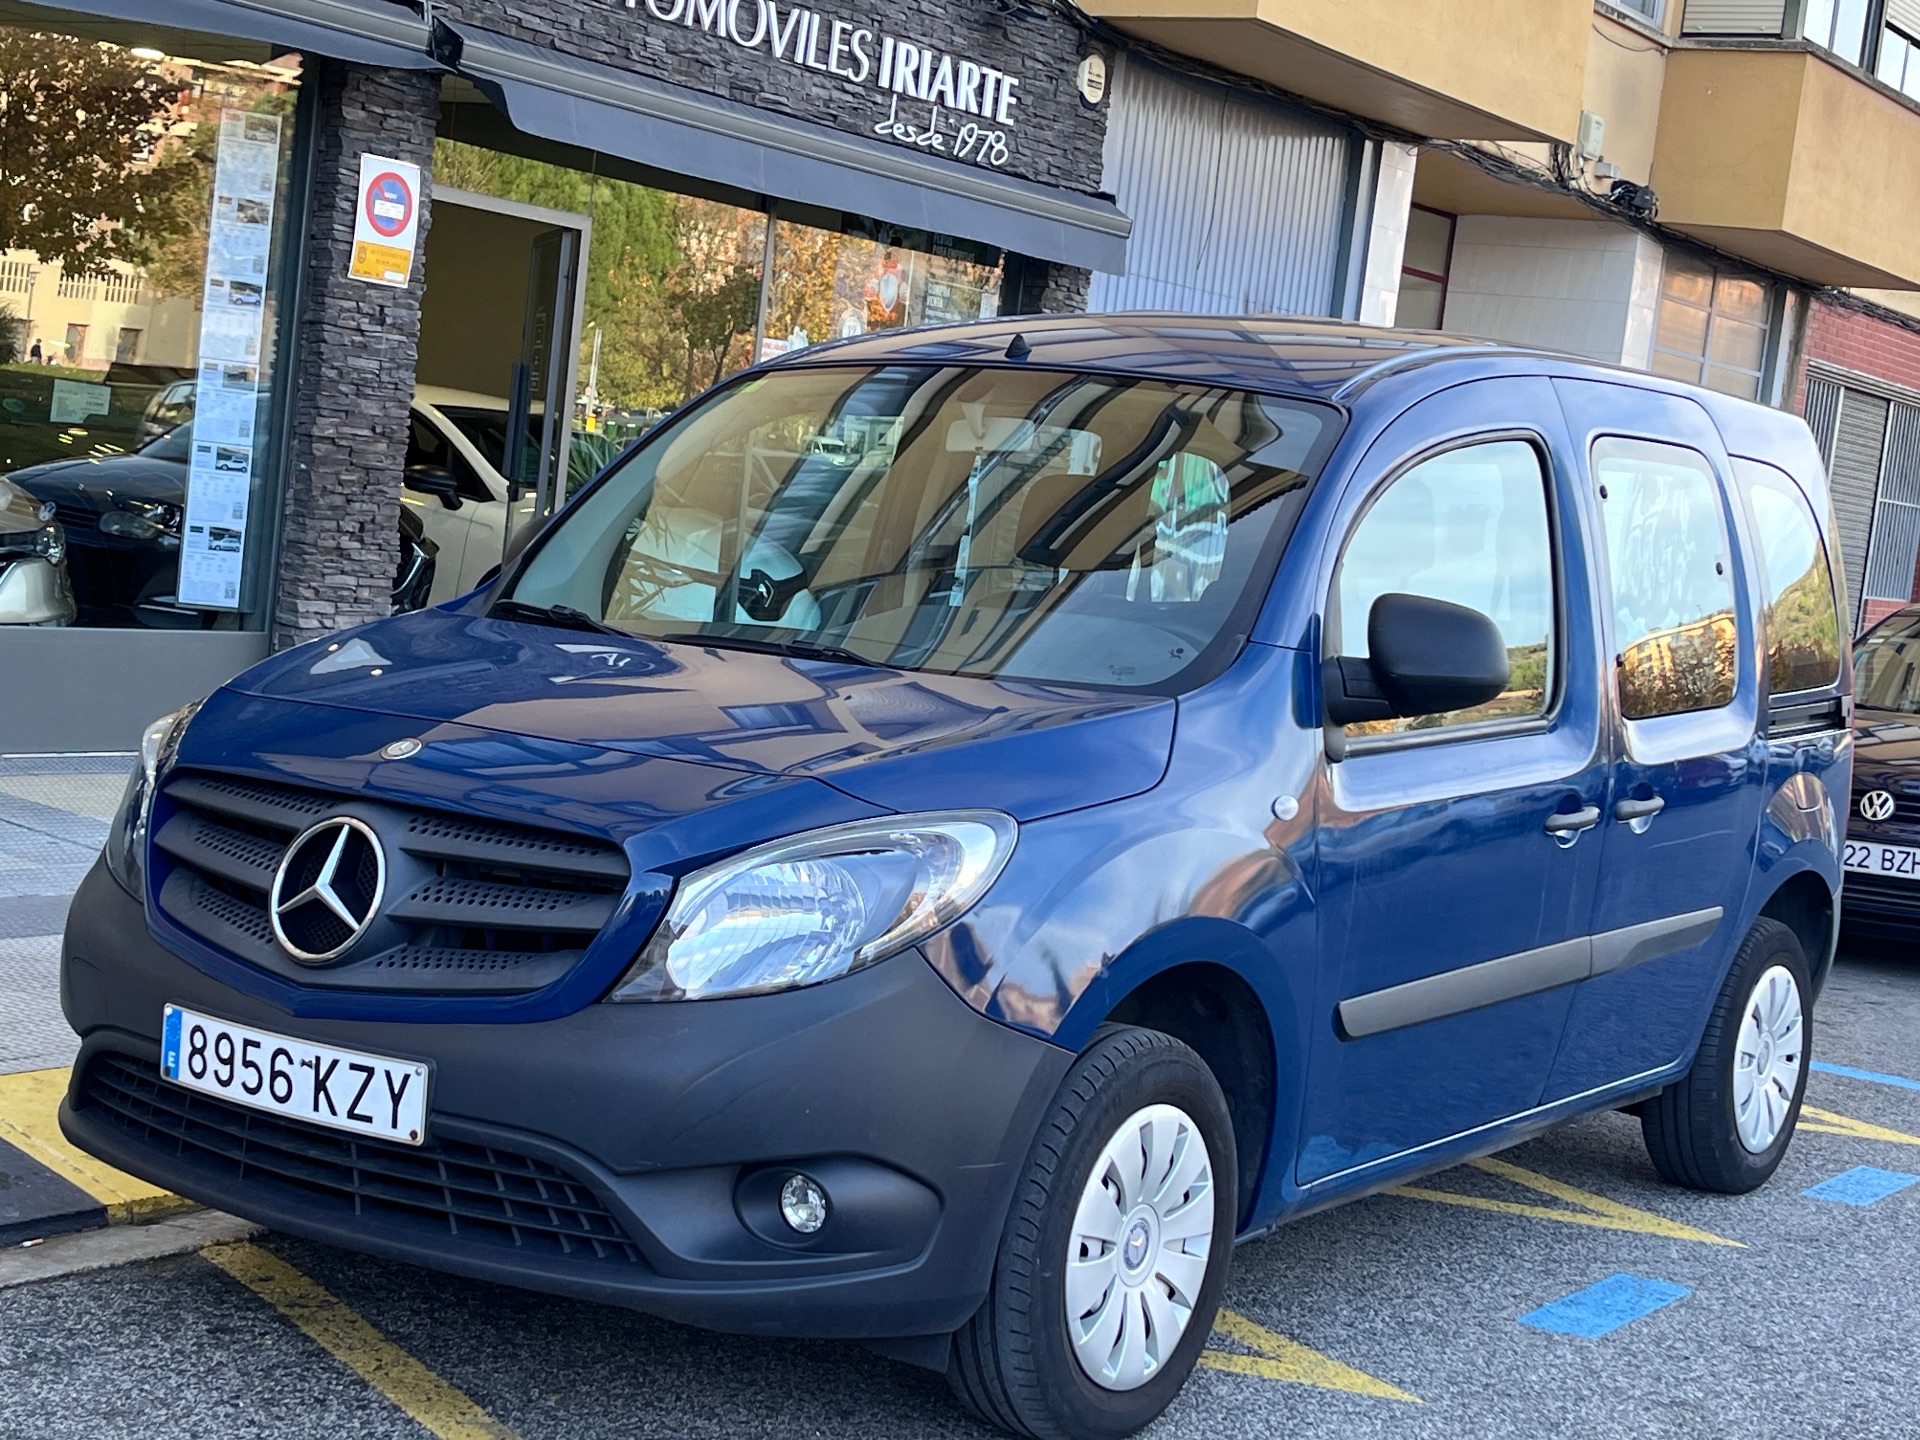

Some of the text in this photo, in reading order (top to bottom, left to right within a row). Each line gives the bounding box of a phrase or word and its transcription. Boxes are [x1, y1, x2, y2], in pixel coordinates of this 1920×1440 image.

[625, 0, 1019, 126] MOVILES IRIARTE
[874, 93, 1009, 166] desde 1978
[167, 1050, 177, 1068] E
[187, 1024, 412, 1129] 8956 KZY
